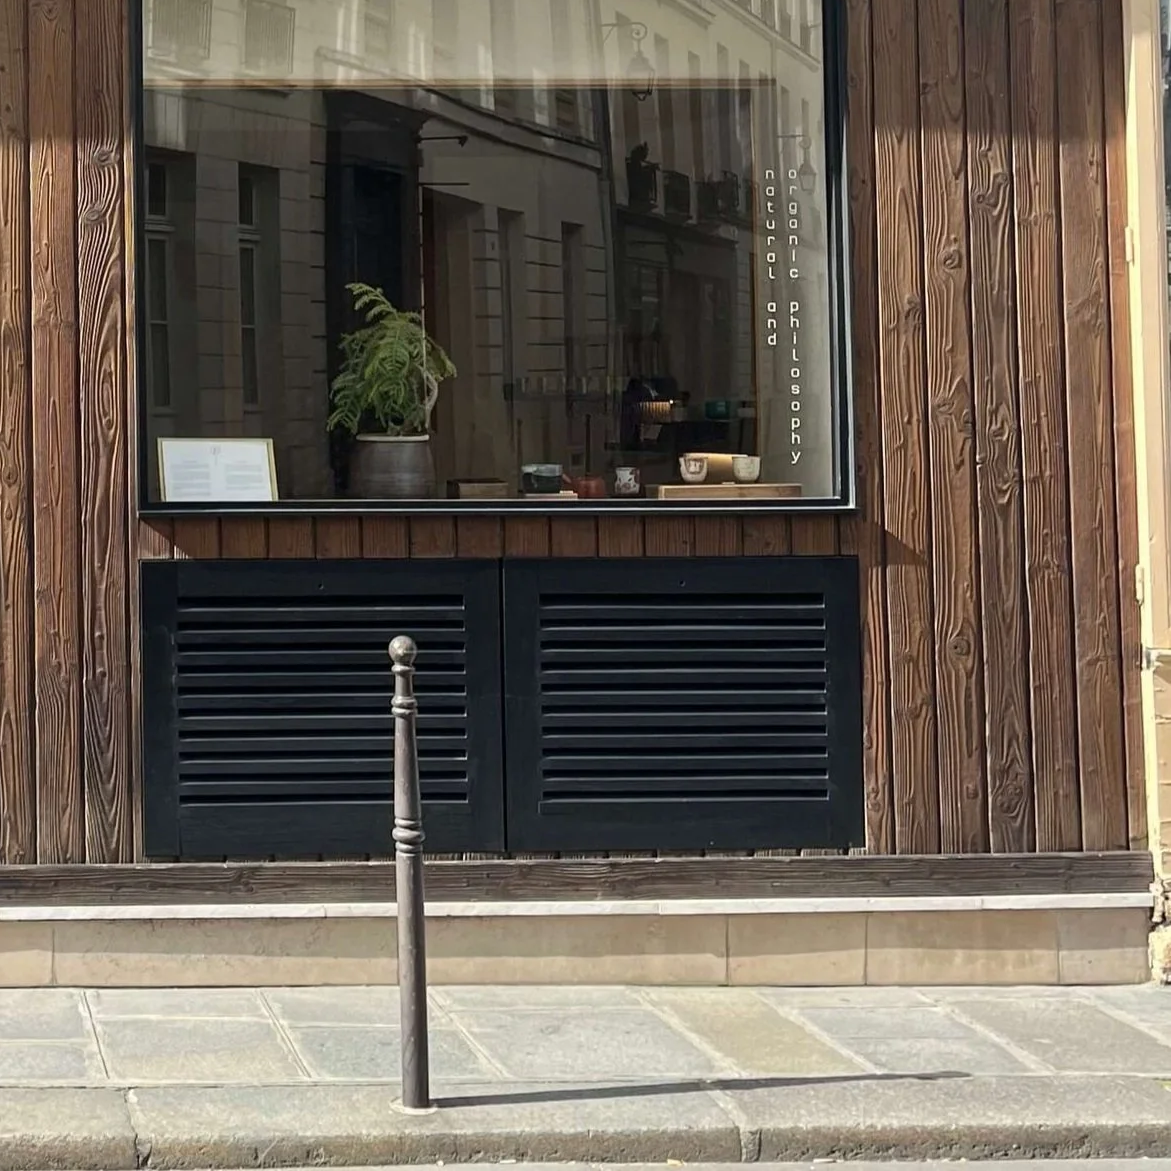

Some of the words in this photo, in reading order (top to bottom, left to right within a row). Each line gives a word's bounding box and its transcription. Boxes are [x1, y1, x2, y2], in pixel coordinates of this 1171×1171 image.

[765, 169, 776, 279] natural
[788, 169, 799, 279] organic
[767, 301, 777, 346] and
[789, 301, 801, 464] philosophy
